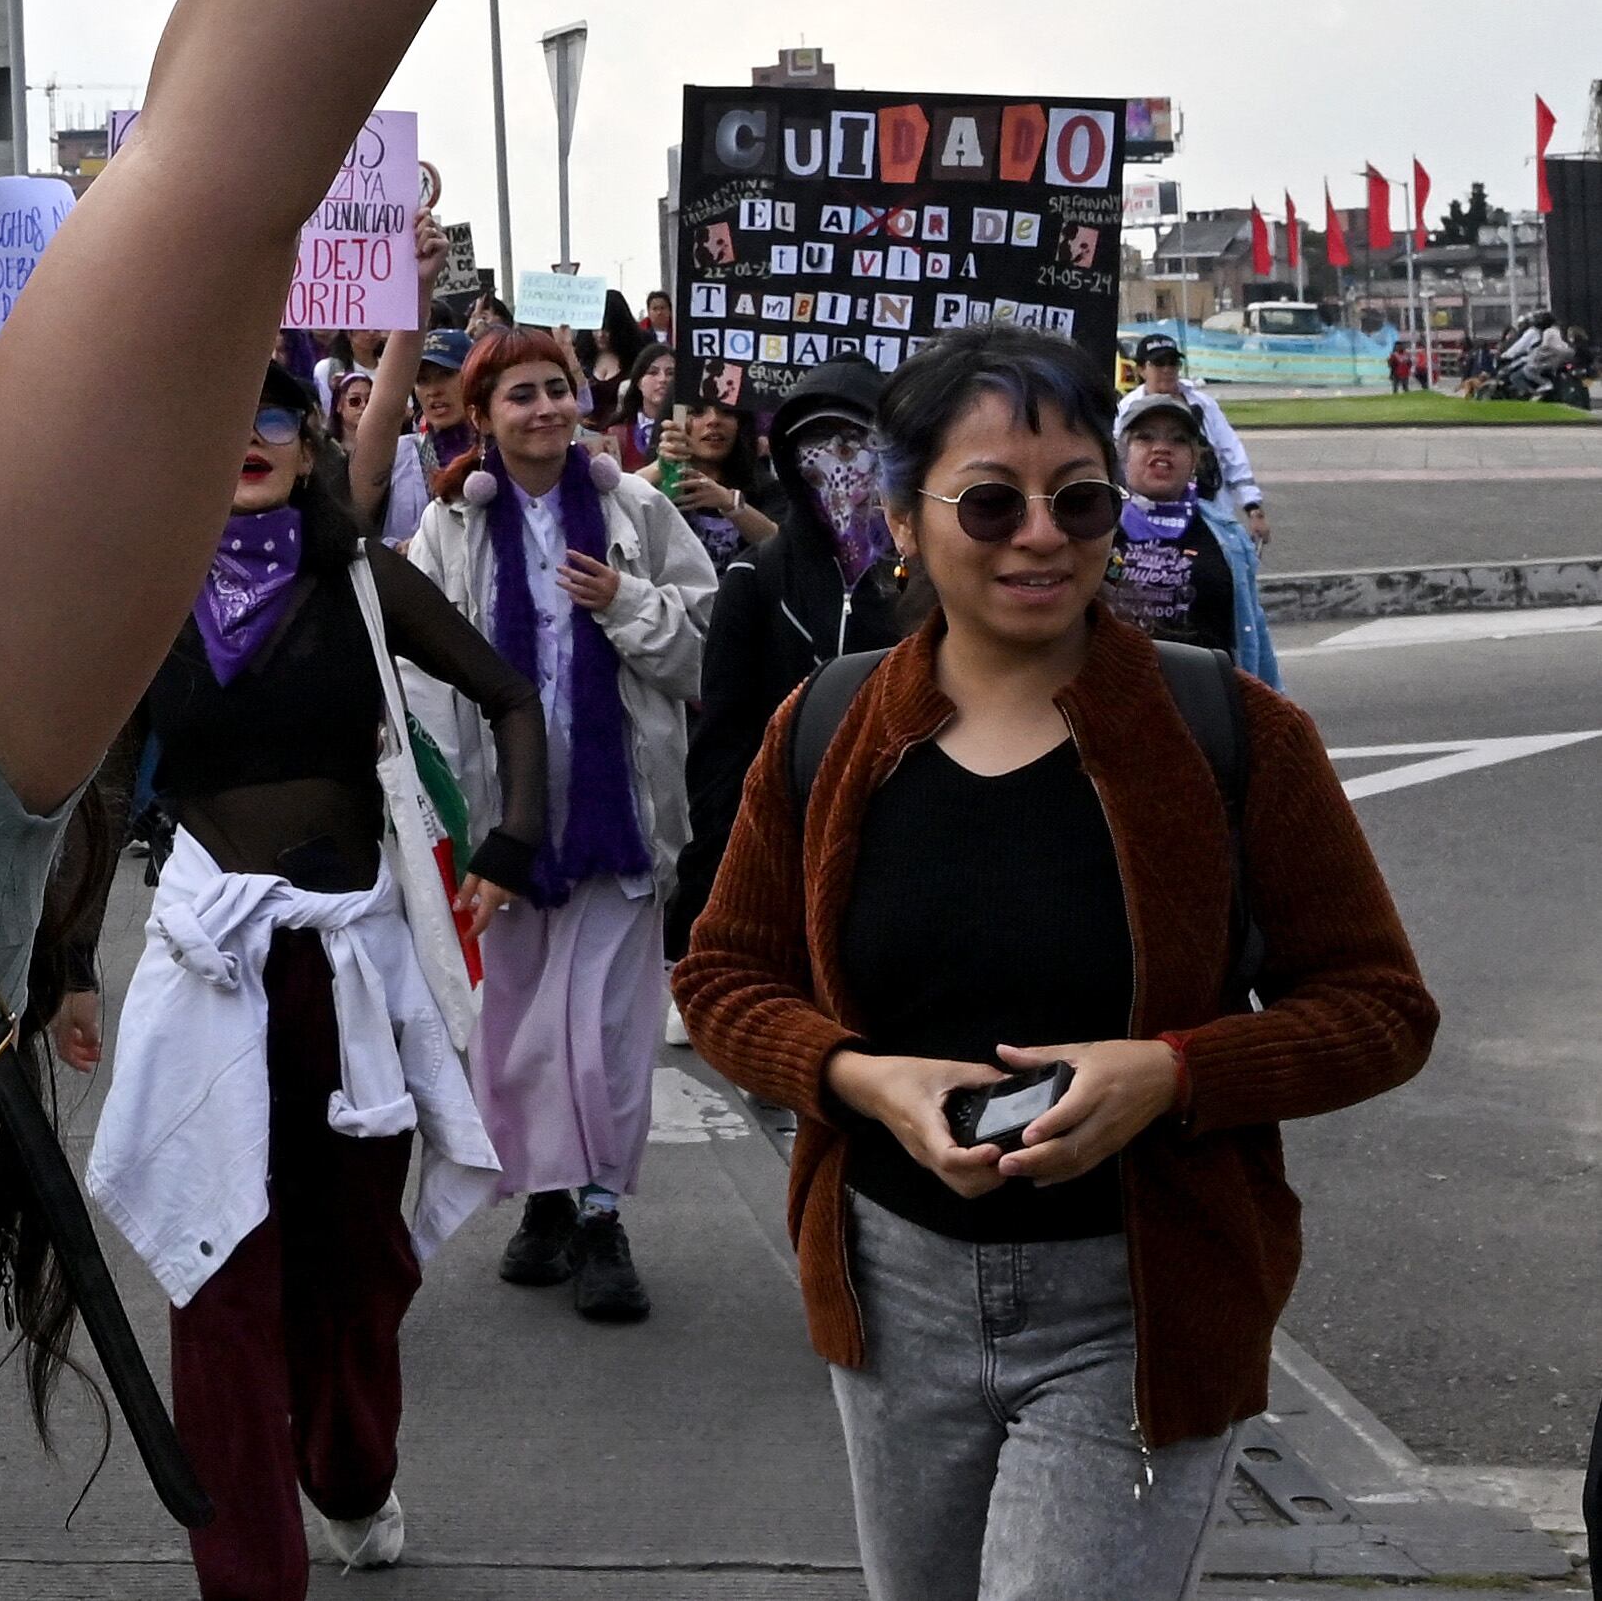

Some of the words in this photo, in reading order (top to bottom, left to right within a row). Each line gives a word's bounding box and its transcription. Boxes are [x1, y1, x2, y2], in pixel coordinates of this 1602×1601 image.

[714, 109, 1106, 184] CUIDADO
[359, 170, 387, 201] YA
[324, 201, 405, 234] DENUNCIADO
[823, 206, 946, 237] AOR
[858, 249, 979, 279] VIDA
[283, 281, 366, 326] ORIR
